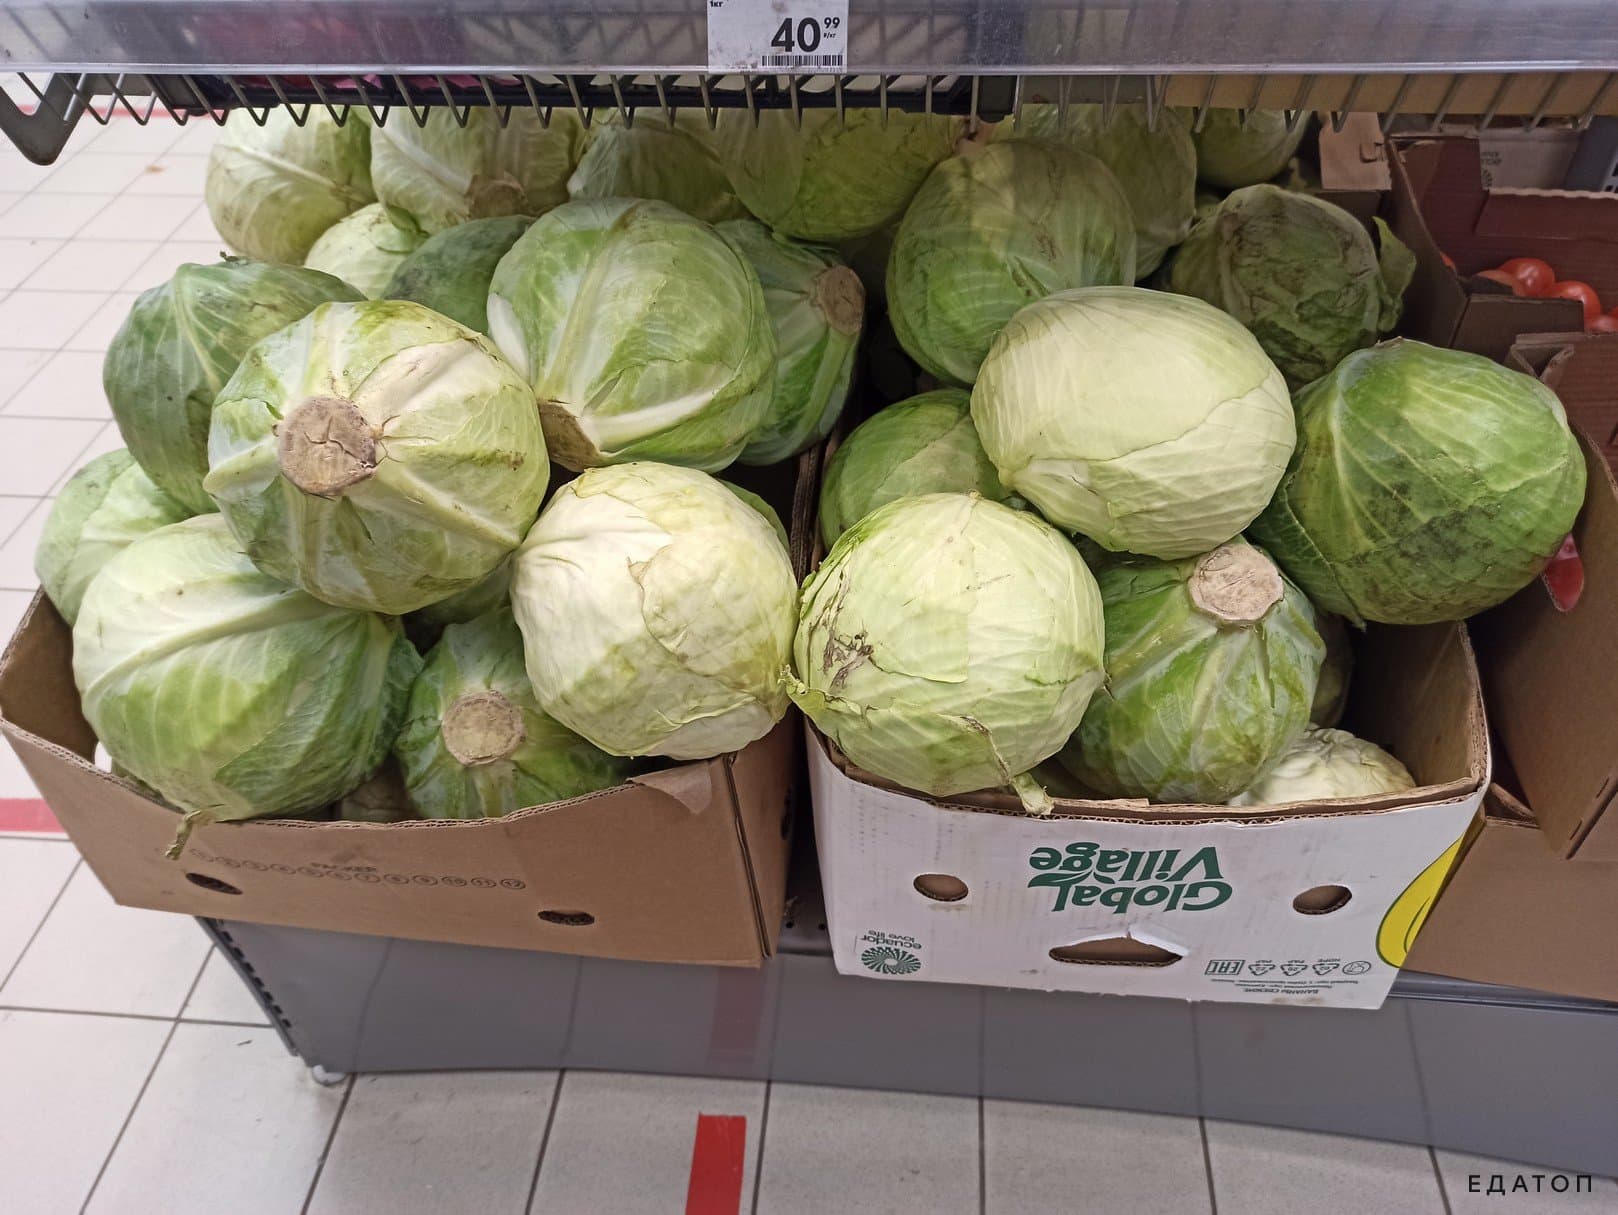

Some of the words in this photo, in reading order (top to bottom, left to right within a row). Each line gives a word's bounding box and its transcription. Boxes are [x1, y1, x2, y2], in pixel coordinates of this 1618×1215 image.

[771, 17, 821, 53] 40
[824, 17, 840, 29] 99
[1029, 842, 1224, 882] Village
[1028, 873, 1233, 914] Global
[861, 935, 922, 950] ecuador
[889, 933, 915, 943] love
